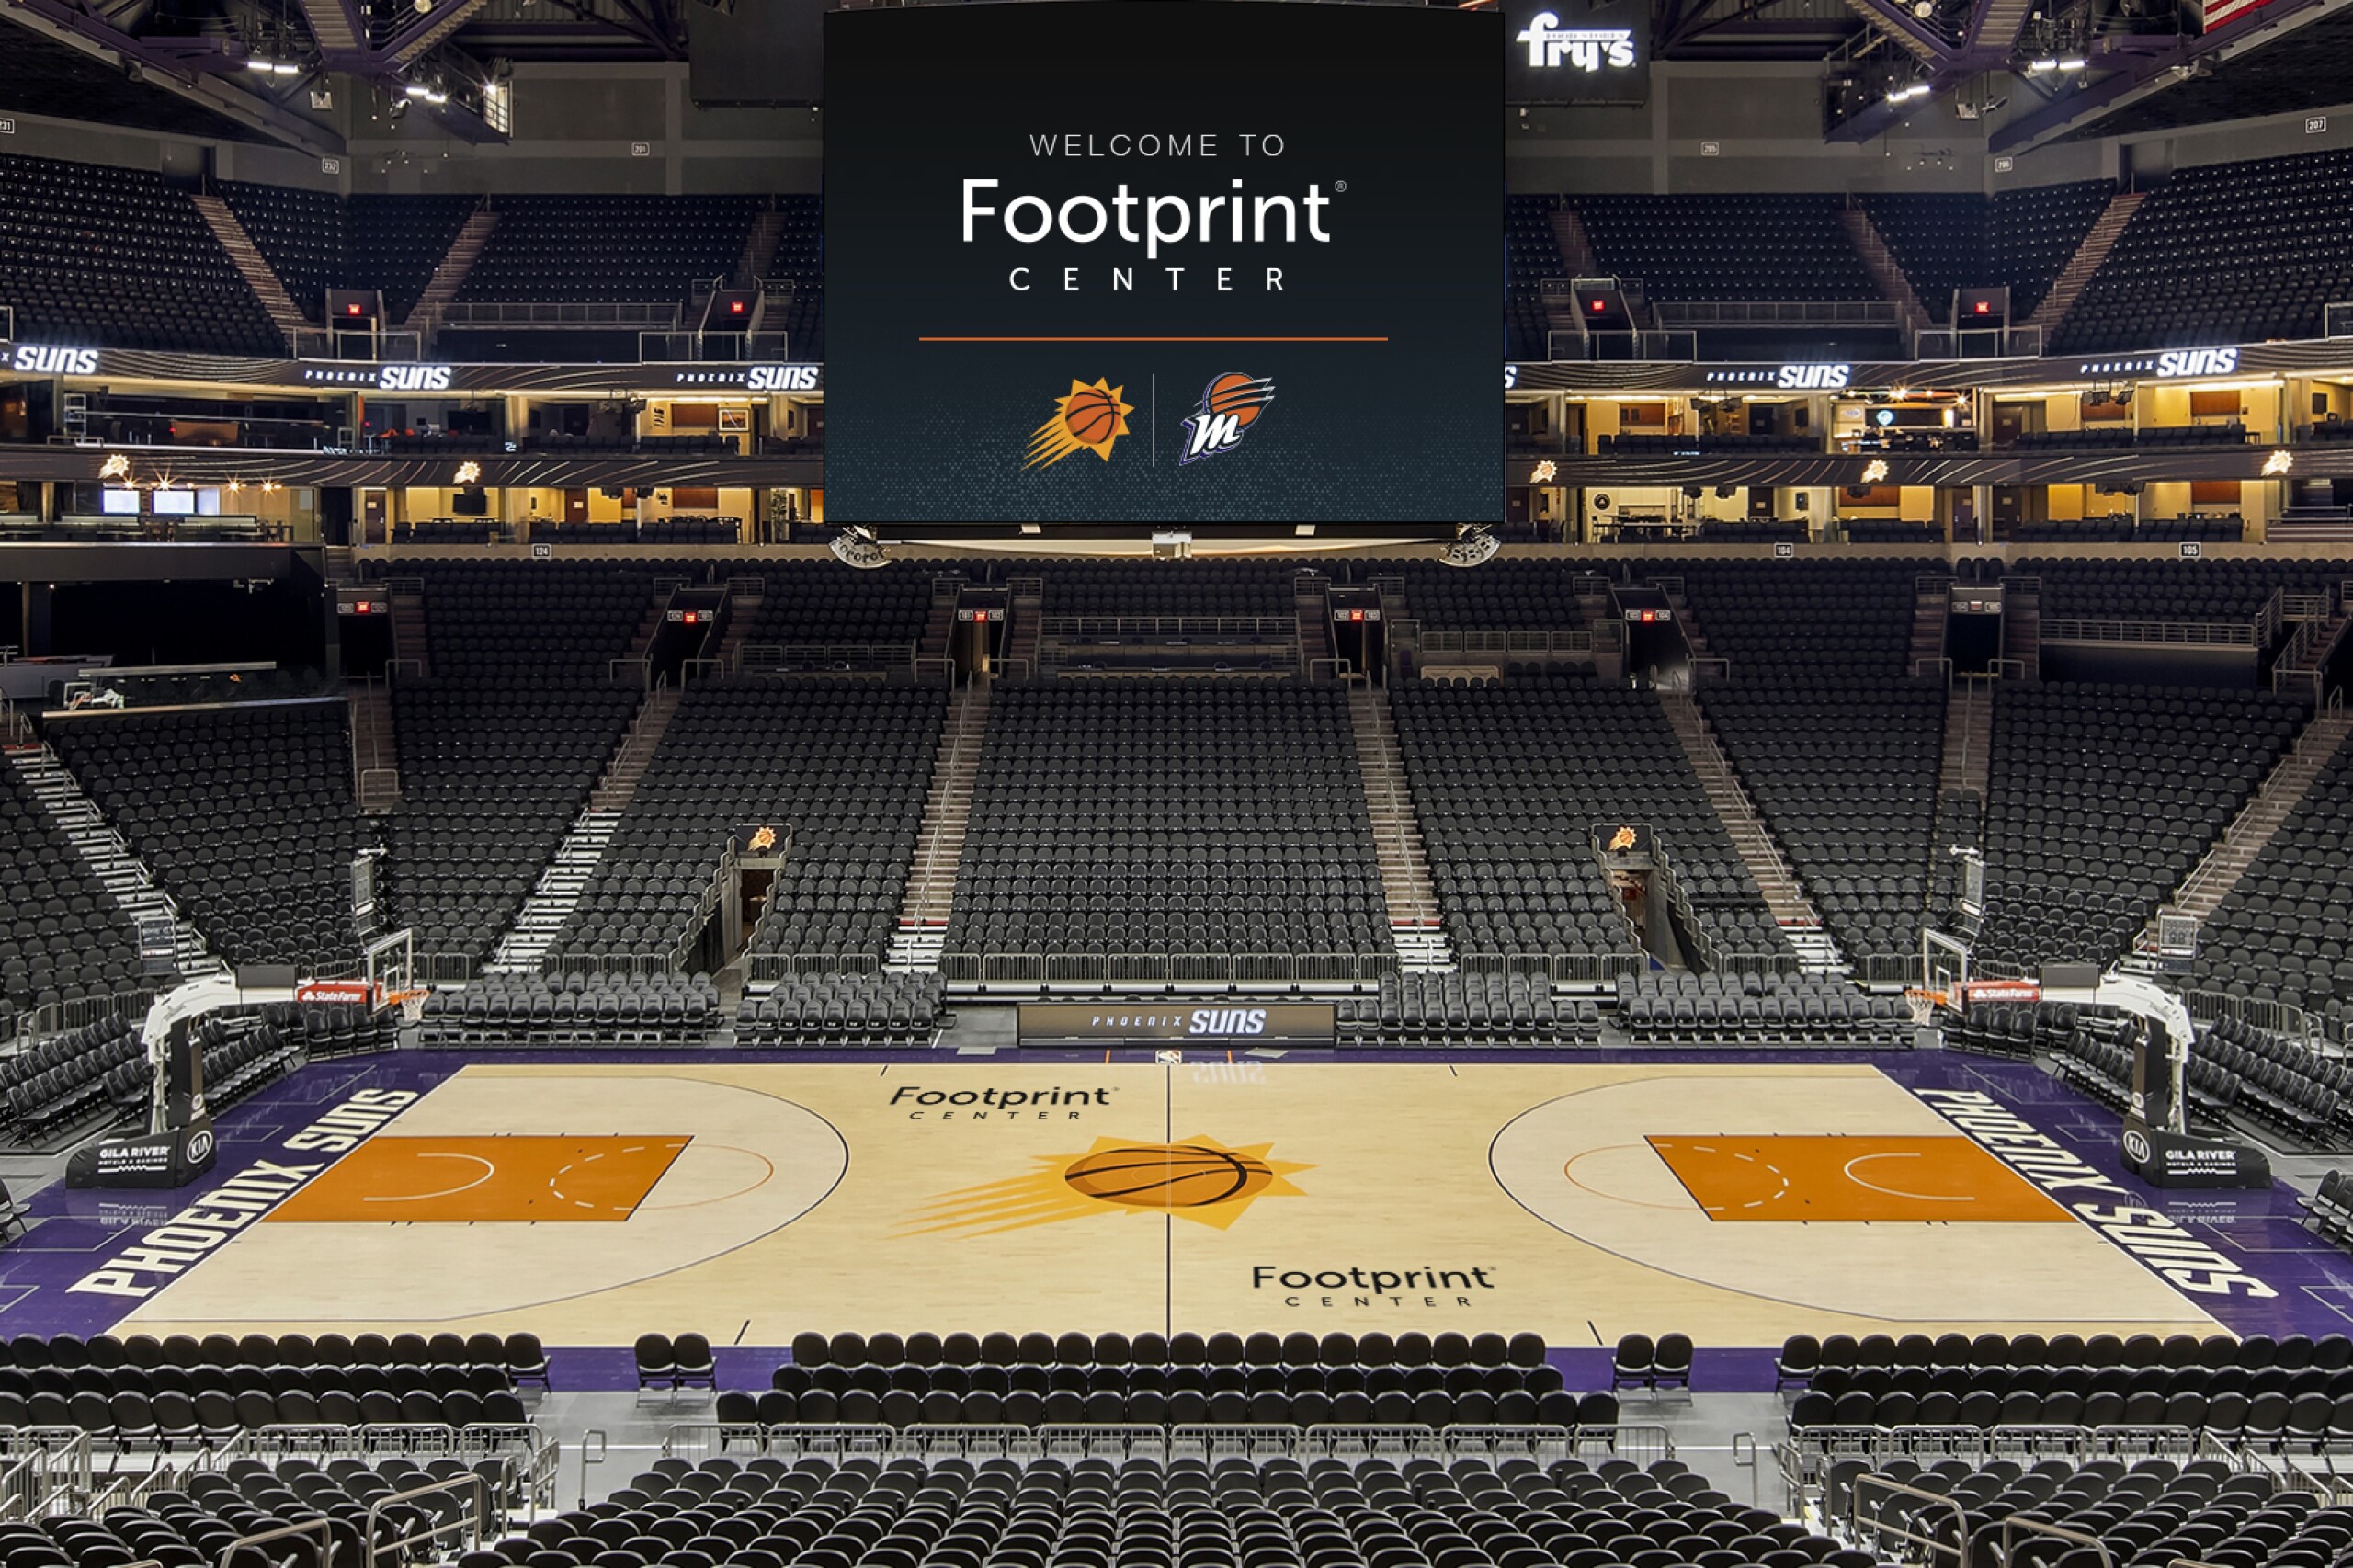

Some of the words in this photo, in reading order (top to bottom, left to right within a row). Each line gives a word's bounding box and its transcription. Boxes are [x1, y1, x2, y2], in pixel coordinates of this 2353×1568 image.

[1516, 12, 1633, 73] fry's
[1029, 134, 1218, 157] WELCOME
[1238, 134, 1285, 157] TO
[1009, 267, 1285, 291] CENTER
[14, 347, 98, 375] SUNS
[2157, 348, 2238, 377] SUNS
[380, 365, 451, 390] SUNS
[748, 366, 819, 390] SUNS
[1778, 365, 1850, 389] SUNS
[1092, 1016, 1183, 1028] PHOENIX
[1188, 1008, 1267, 1034] SUNS
[909, 1110, 1081, 1120] CENTER
[99, 1147, 129, 1159] GILA
[131, 1145, 169, 1157] RIVER
[2165, 1150, 2196, 1160] GILA
[2196, 1150, 2235, 1160] RIVER
[65, 1160, 324, 1298] PHOENIX
[283, 1088, 419, 1153] SUNS
[1913, 1088, 2131, 1193] PHOENIX
[2072, 1202, 2279, 1298] SUNS
[1284, 1296, 1472, 1308] CENTER
